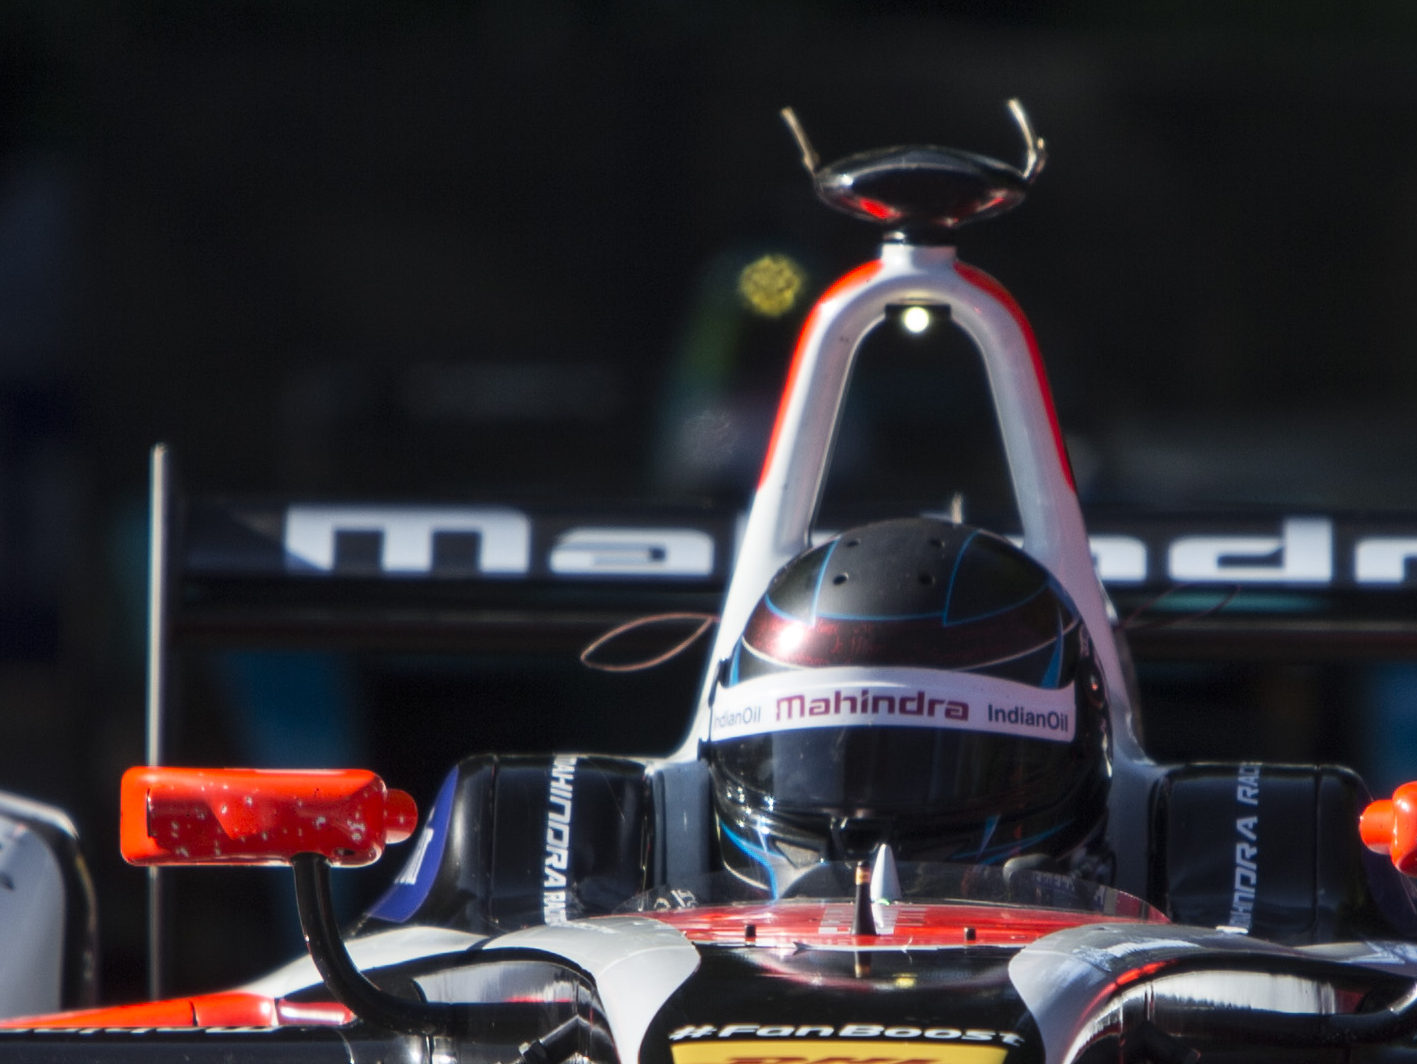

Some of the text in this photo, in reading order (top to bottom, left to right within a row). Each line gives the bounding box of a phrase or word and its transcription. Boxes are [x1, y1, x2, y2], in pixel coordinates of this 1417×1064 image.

[775, 690, 970, 722] Mahindra
[988, 704, 1070, 733] IndianOil
[669, 1023, 1025, 1047] #FanBoost
